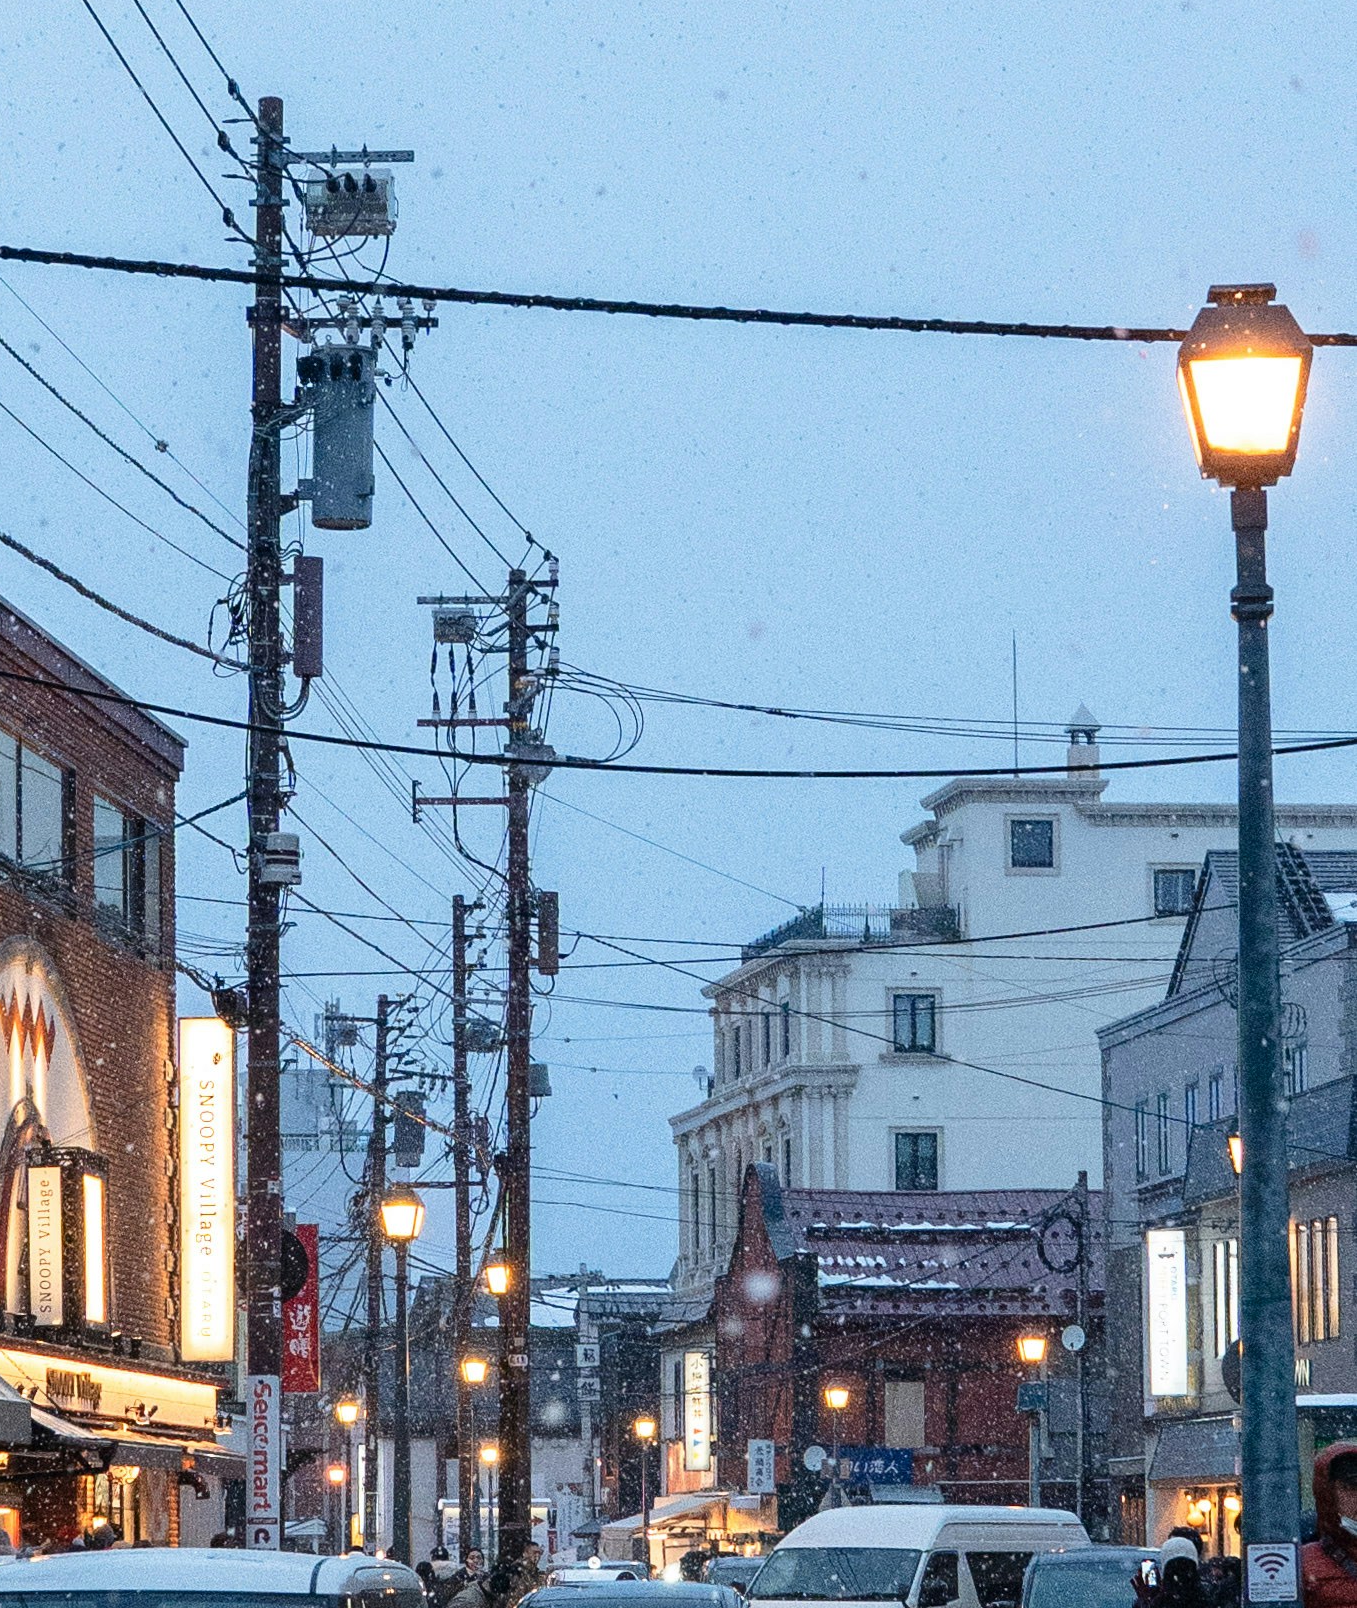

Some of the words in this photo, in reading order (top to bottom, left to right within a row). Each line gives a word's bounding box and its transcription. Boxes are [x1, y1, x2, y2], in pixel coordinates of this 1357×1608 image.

[199, 1079, 215, 1167] SNOOPY
[37, 1179, 53, 1240] Village
[195, 1177, 217, 1256] Village
[38, 1247, 52, 1313] SNOOPY
[200, 1271, 212, 1338] OTARU
